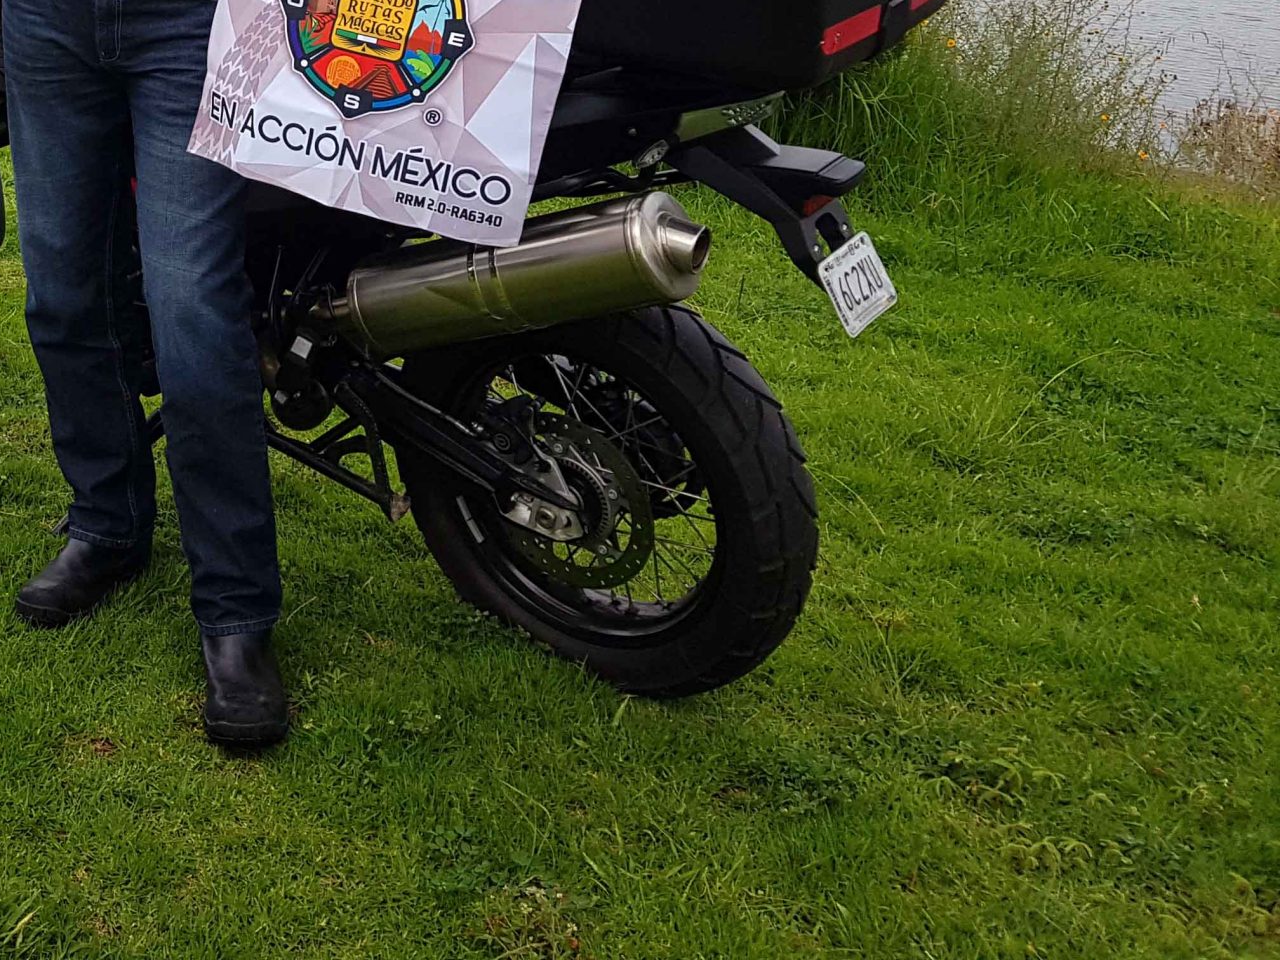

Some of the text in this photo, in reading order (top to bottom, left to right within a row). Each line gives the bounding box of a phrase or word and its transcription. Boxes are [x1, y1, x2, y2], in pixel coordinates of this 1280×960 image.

[448, 32, 466, 48] E
[343, 93, 361, 110] S
[210, 90, 512, 206] EN ACCIÓN MÉXICO
[394, 191, 503, 228] RRM 2.0-RA6340
[838, 254, 884, 311] 6C2XU
